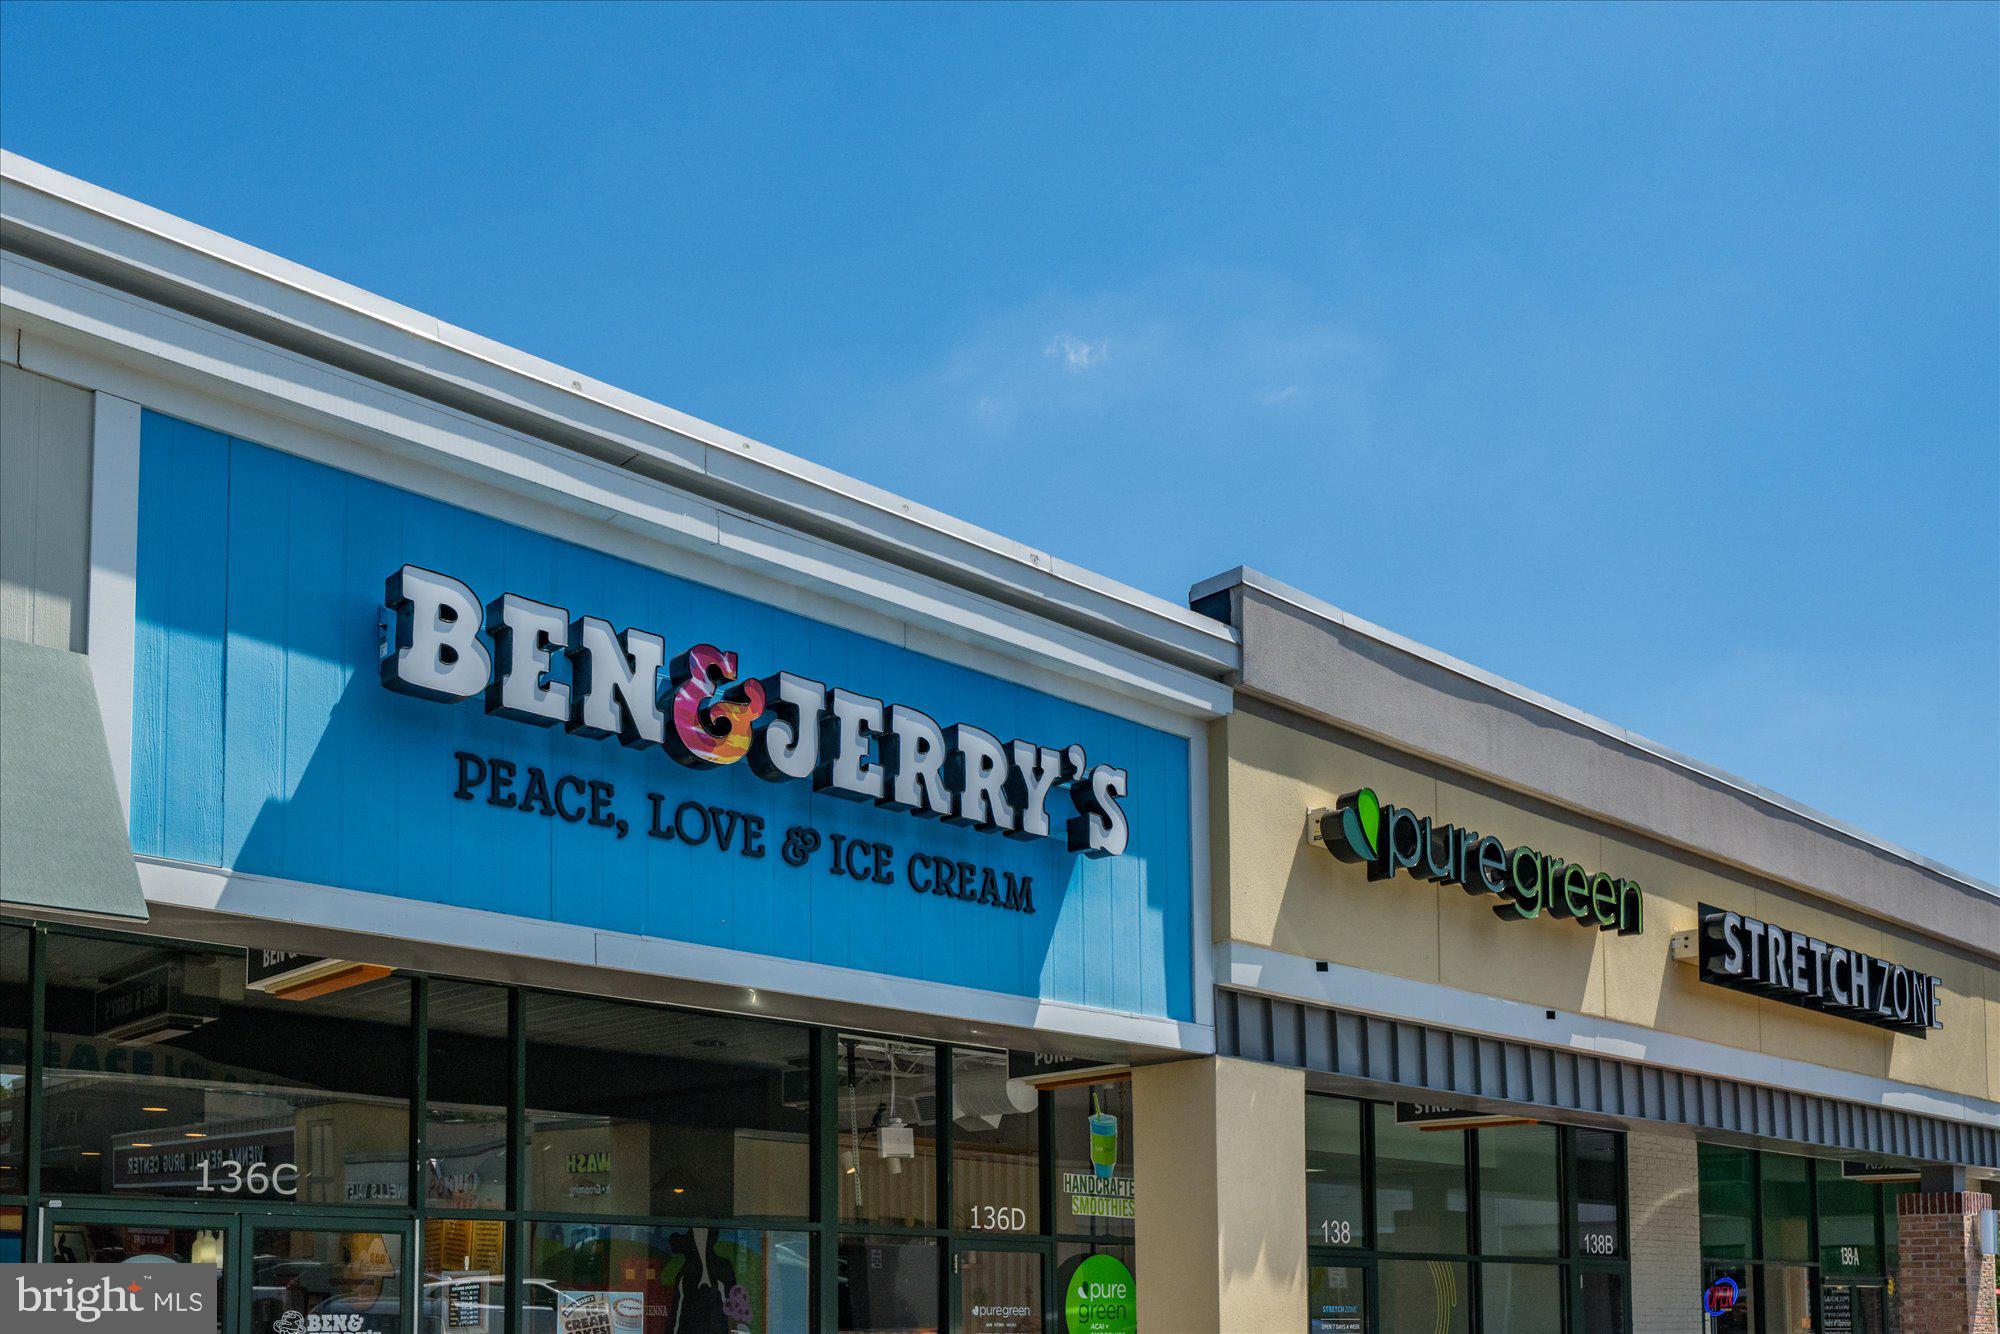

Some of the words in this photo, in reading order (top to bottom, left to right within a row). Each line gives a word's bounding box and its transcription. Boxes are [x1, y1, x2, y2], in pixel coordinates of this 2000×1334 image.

[454, 751, 629, 839] PEACE,
[647, 793, 765, 858] LOVE
[781, 825, 821, 867] &
[830, 833, 894, 884] ICE
[908, 852, 1036, 913] CREAM
[1722, 911, 1871, 1010] STRETCH
[1877, 959, 1944, 1030] ZONE
[197, 1160, 298, 1195] 136C
[970, 1205, 1026, 1231] 136D
[1073, 1196, 1135, 1217] SMOOTHIES
[1321, 1220, 1351, 1244] 138
[1584, 1234, 1614, 1255] 138B
[1090, 1283, 1127, 1302] pure
[1708, 1286, 1733, 1310] OPEN
[564, 1314, 610, 1331] CREAM
[1079, 1304, 1127, 1323] green
